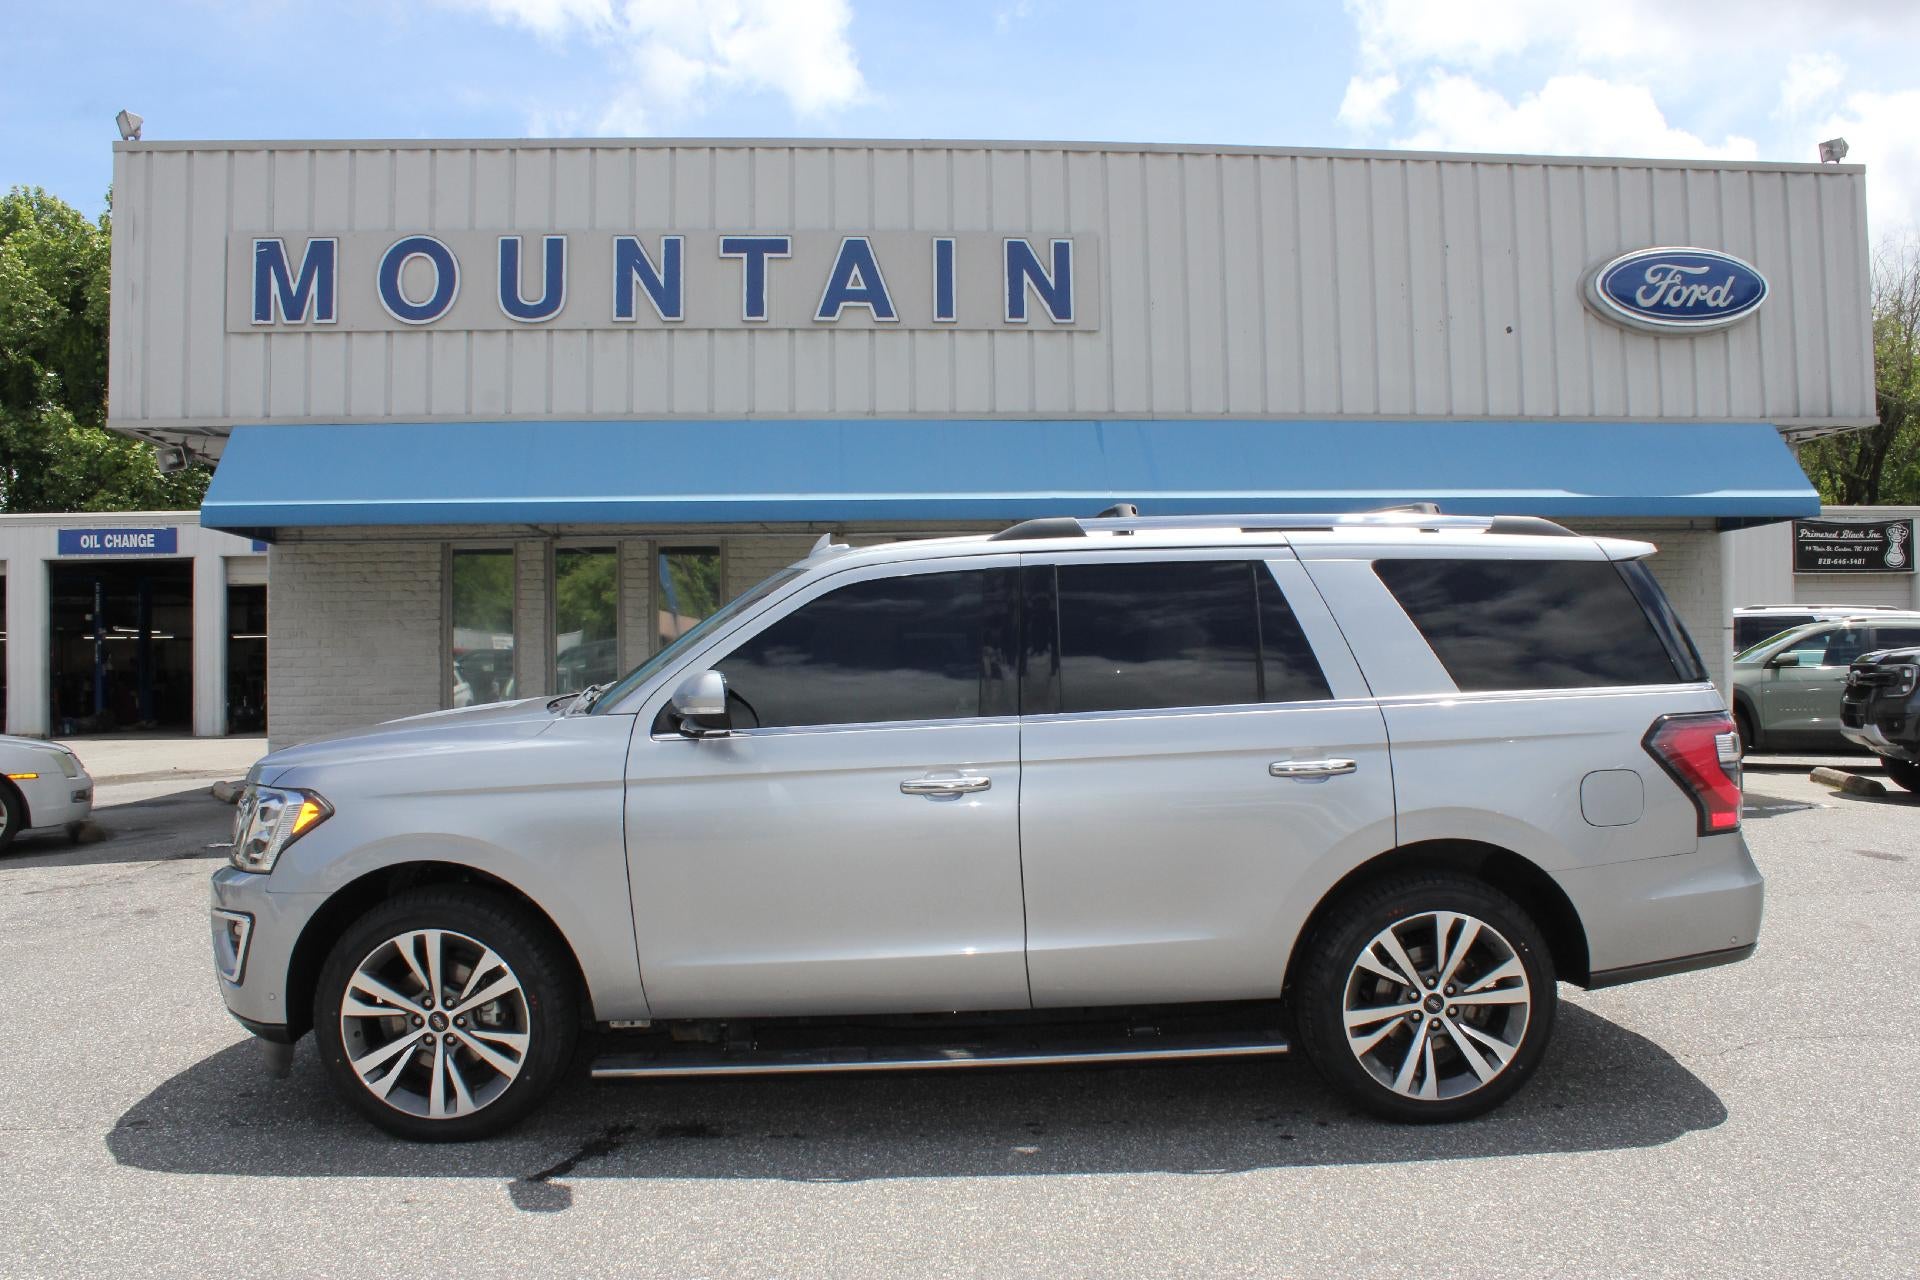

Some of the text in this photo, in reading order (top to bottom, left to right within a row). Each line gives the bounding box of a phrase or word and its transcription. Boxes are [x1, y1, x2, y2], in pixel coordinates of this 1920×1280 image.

[251, 234, 1075, 325] MOUNTAIN
[1635, 263, 1735, 308] Ford
[80, 533, 155, 548] OIL CHANGE
[1799, 528, 1839, 538] Primered
[1840, 529, 1864, 539] Black
